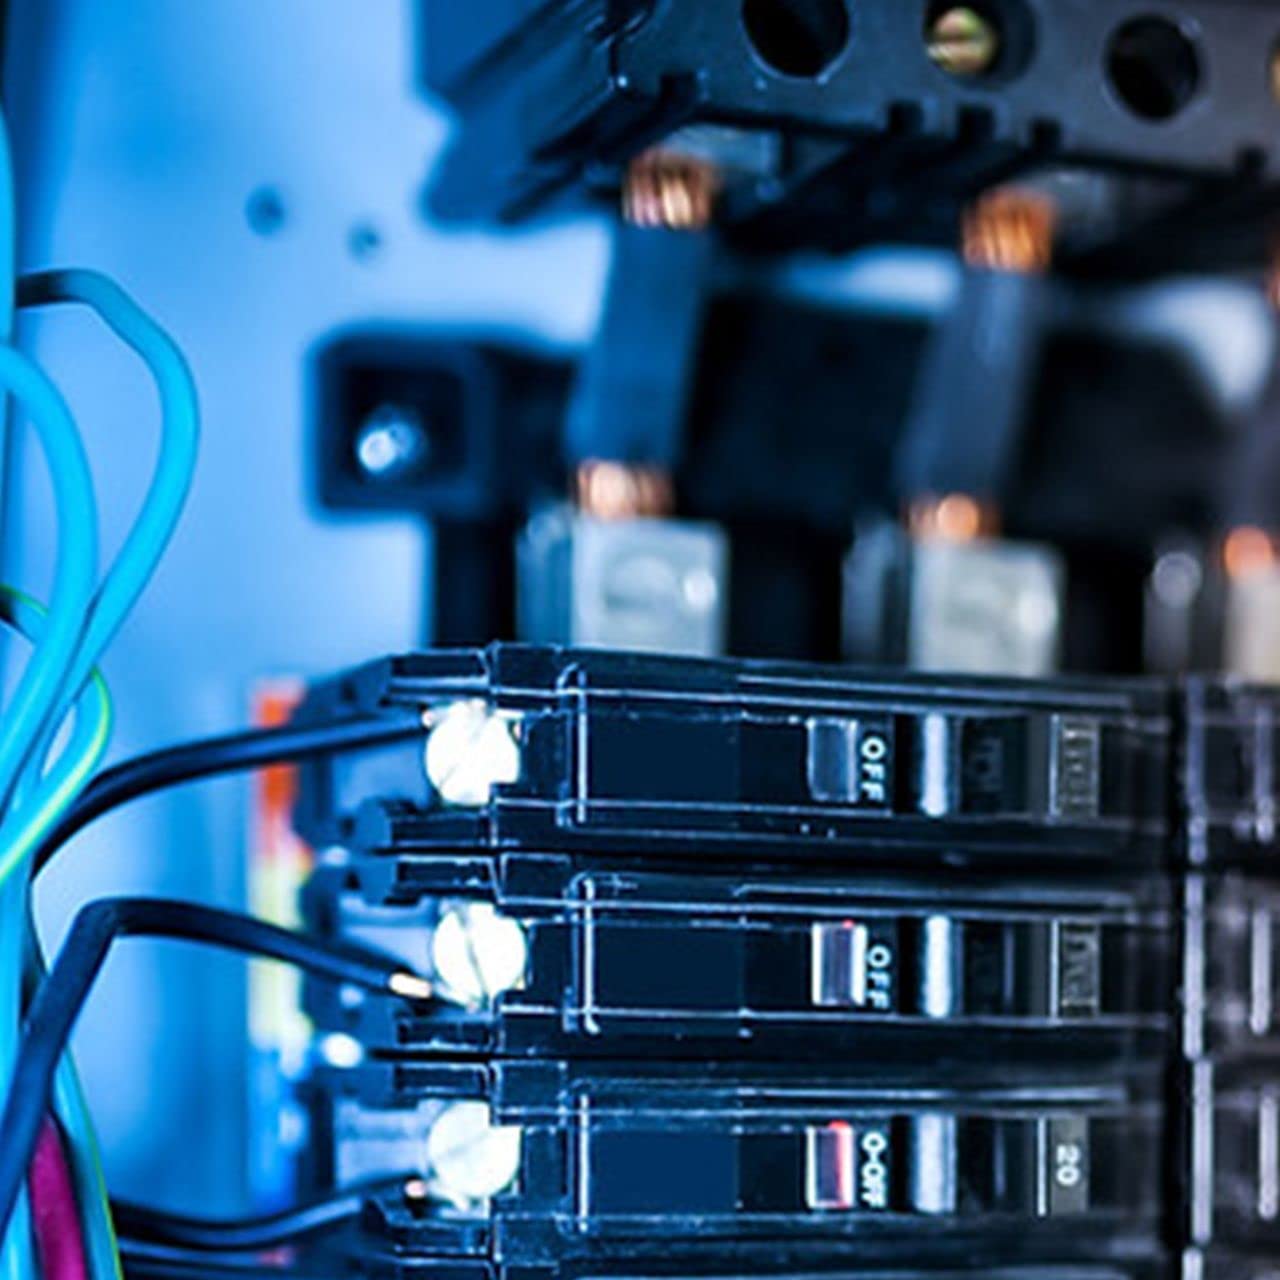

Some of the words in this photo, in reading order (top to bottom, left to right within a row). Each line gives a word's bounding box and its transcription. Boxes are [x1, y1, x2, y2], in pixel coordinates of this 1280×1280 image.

[860, 737, 886, 801] OFF
[867, 945, 891, 1009] OFF
[1056, 1144, 1080, 1186] 20
